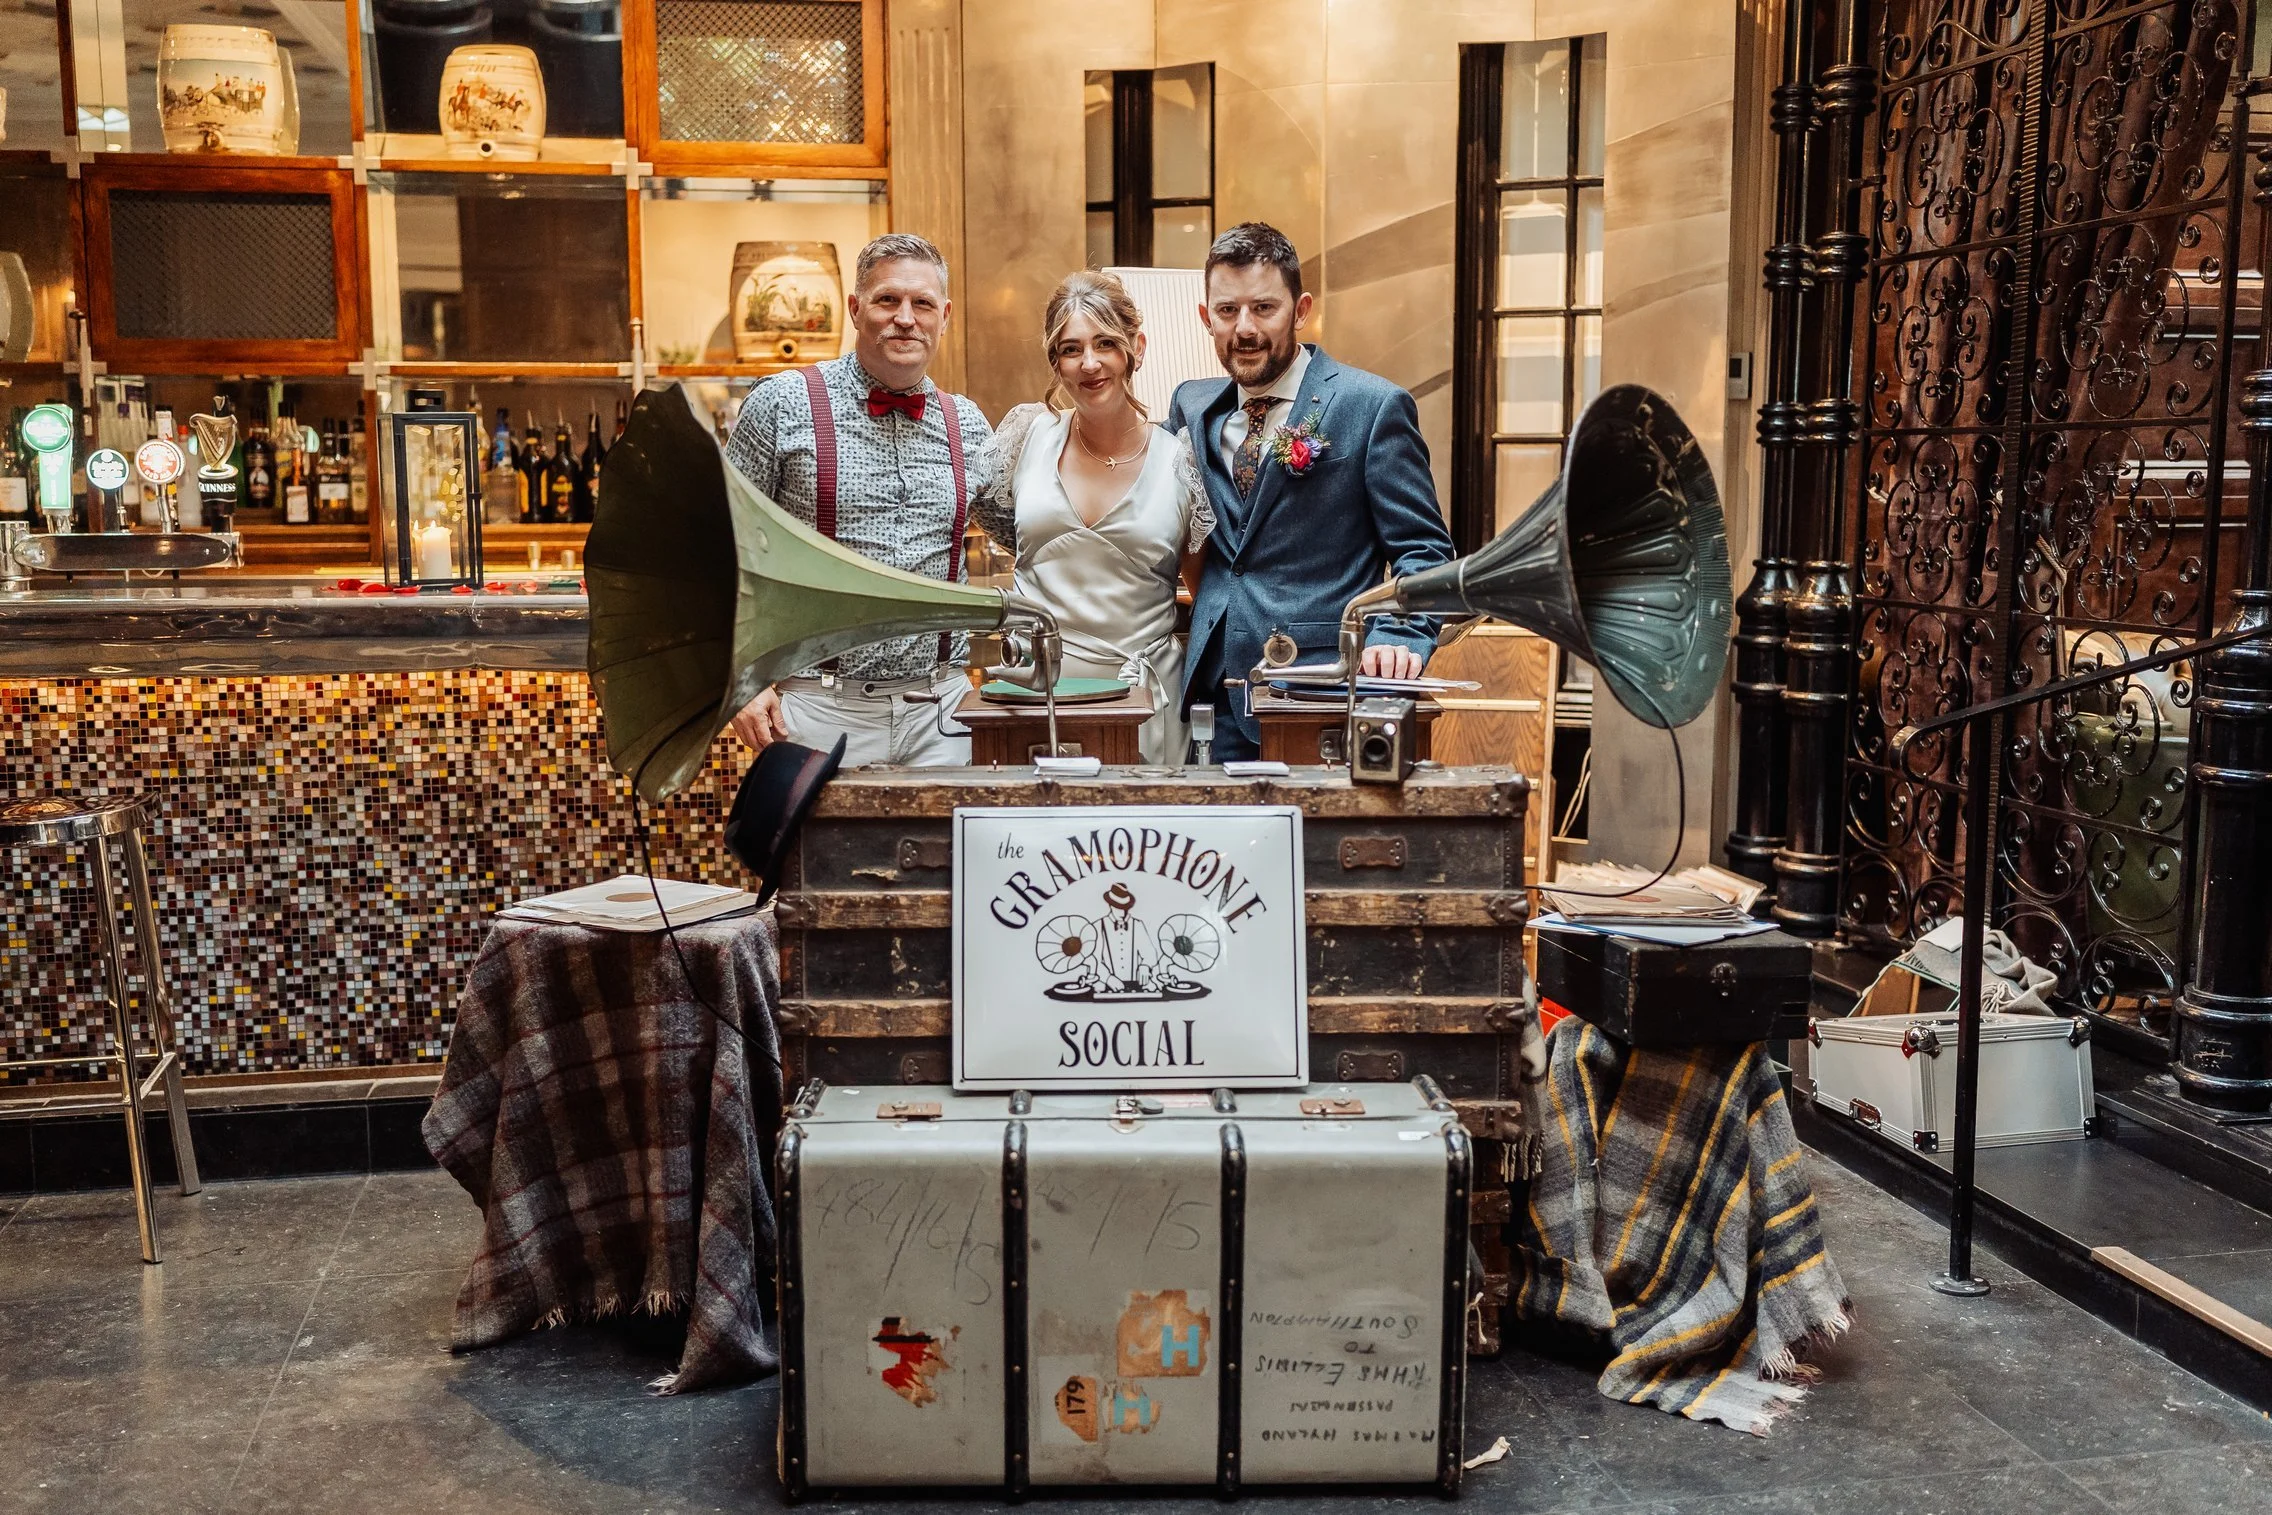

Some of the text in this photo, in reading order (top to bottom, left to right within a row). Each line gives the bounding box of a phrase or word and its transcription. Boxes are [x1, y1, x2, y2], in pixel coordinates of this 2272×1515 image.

[198, 482, 236, 493] GUINNESS
[997, 832, 1024, 859] the
[990, 827, 1267, 934] GRAMOPHONE
[1058, 1020, 1205, 1068] SOCIAL
[1250, 1312, 1418, 1339] SOUTHAMPTON
[1162, 1325, 1200, 1368] H
[1344, 1341, 1376, 1354] TO
[1066, 1380, 1086, 1415] 179
[1114, 1392, 1151, 1425] H
[1262, 1429, 1337, 1442] HYLAND
